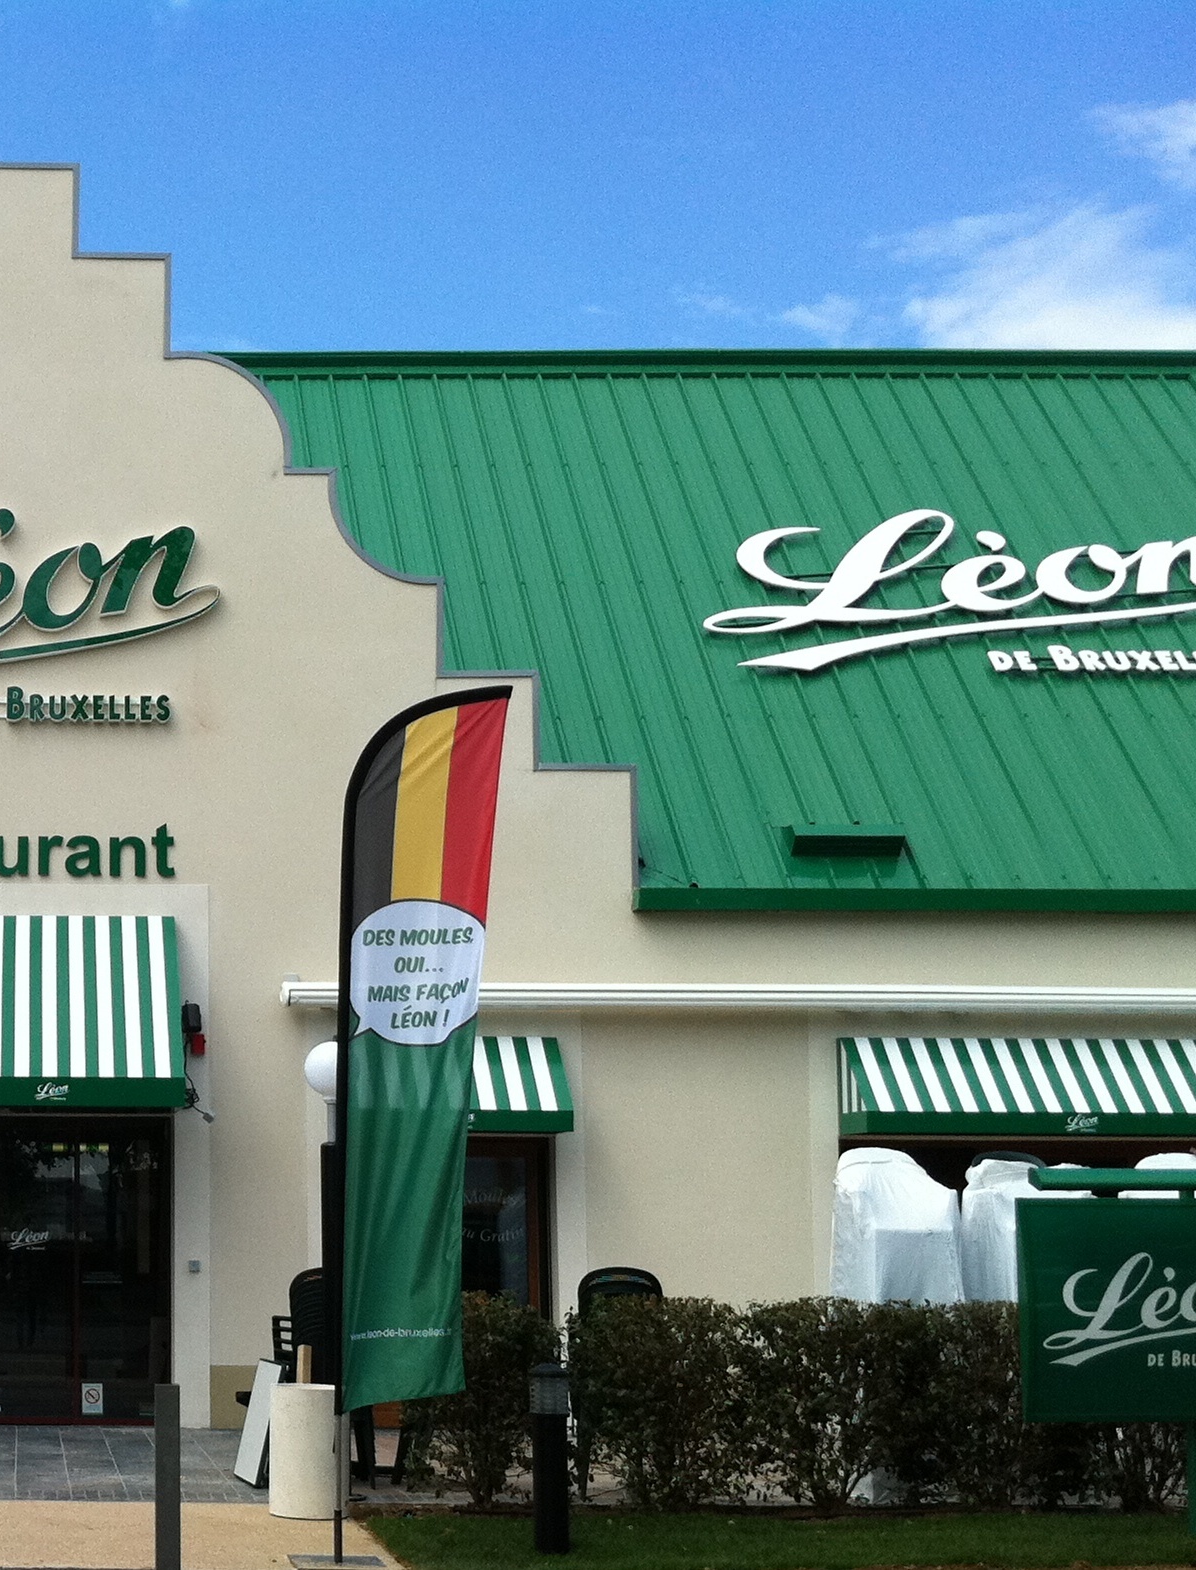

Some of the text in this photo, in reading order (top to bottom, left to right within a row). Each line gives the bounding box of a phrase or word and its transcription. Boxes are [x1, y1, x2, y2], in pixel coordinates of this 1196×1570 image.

[987, 645, 1196, 671] DE BRUXEL
[363, 928, 395, 946] DES
[394, 956, 445, 973] OUI...
[367, 977, 469, 1004] MAIS FAÇON
[390, 1005, 438, 1029] LÉON
[1147, 1353, 1164, 1367] DE
